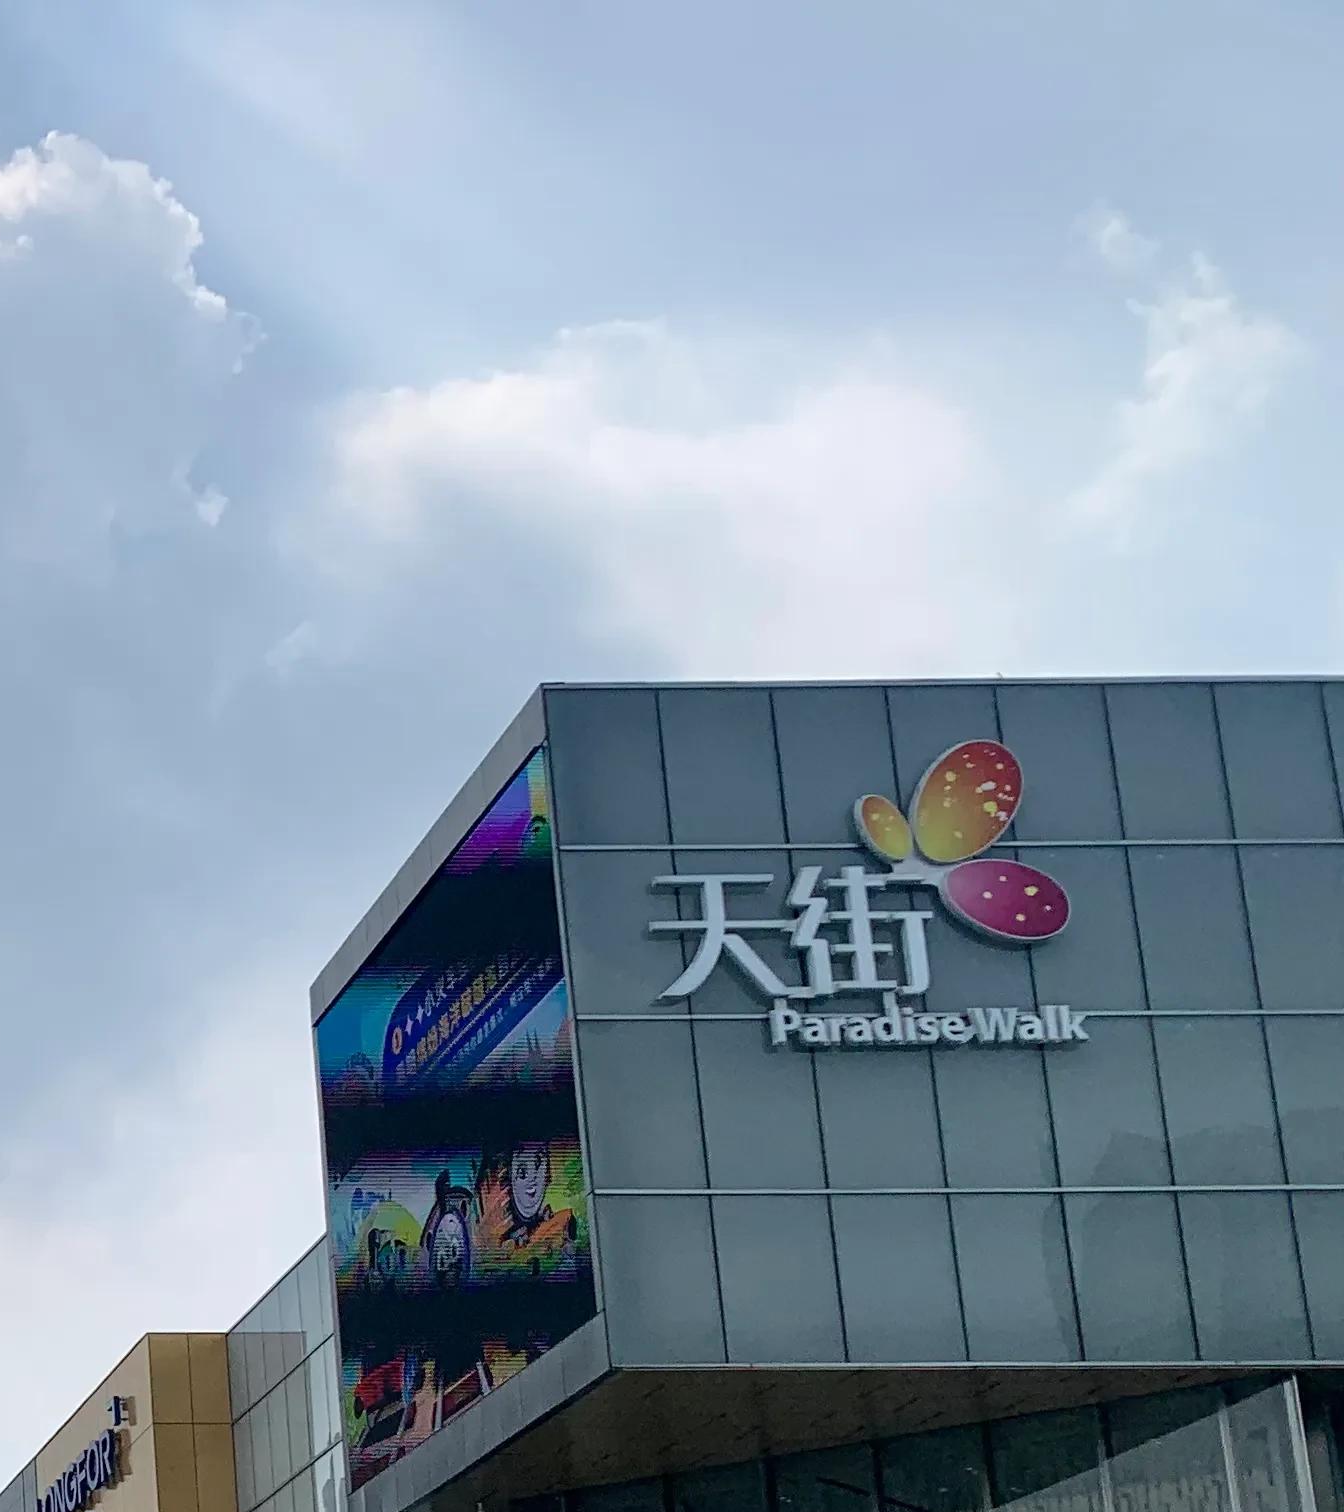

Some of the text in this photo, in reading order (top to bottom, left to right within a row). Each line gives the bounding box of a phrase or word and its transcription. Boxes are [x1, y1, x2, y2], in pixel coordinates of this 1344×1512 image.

[648, 866, 933, 1000] 天街
[769, 994, 1090, 1045] Paradise Walk
